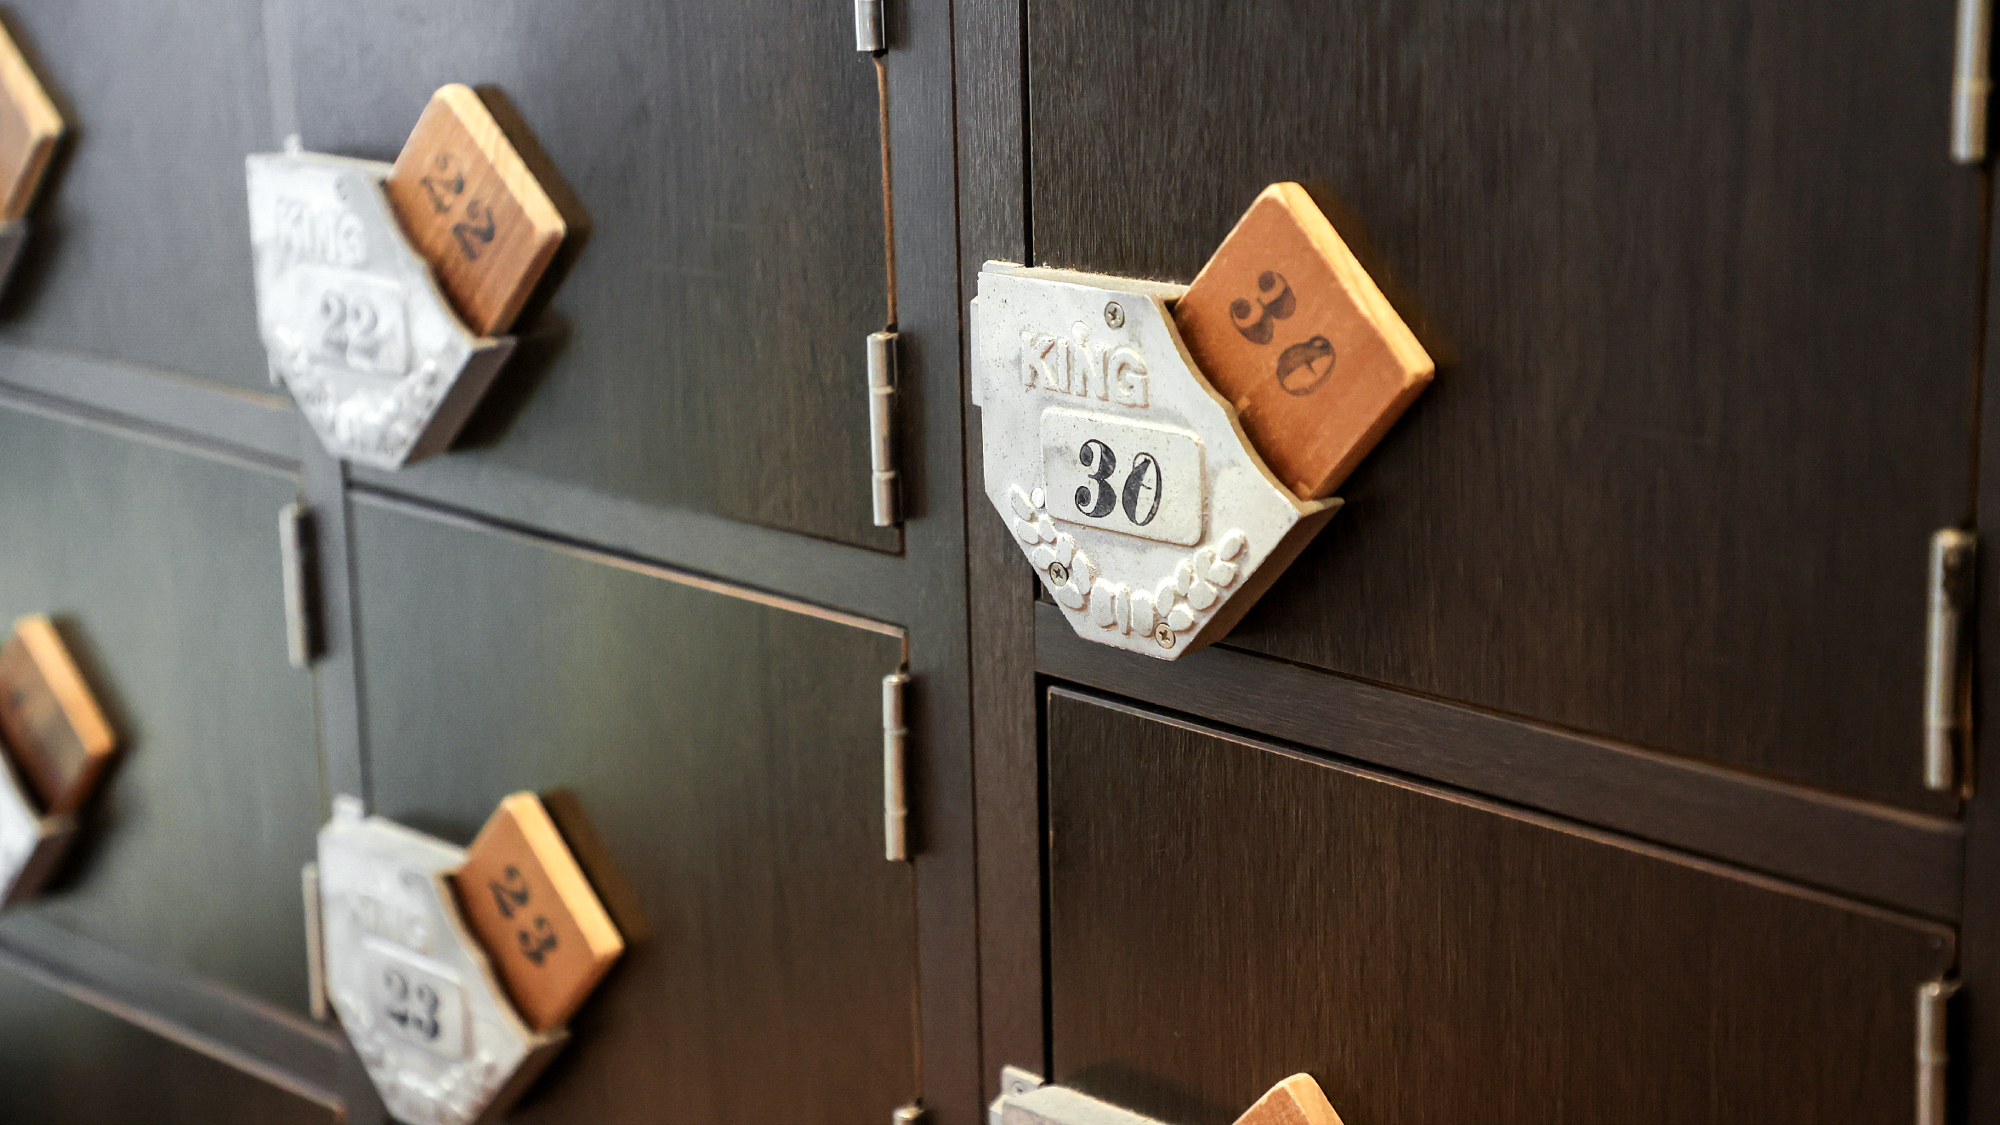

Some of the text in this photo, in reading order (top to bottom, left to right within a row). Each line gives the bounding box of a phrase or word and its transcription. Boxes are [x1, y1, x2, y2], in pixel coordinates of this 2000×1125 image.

[419, 151, 496, 261] 22
[319, 288, 381, 362] 22
[1020, 330, 1149, 407] KING
[1230, 270, 1336, 396] 30
[1075, 438, 1162, 526] 30
[488, 864, 558, 968] 23
[383, 968, 440, 1041] 23
